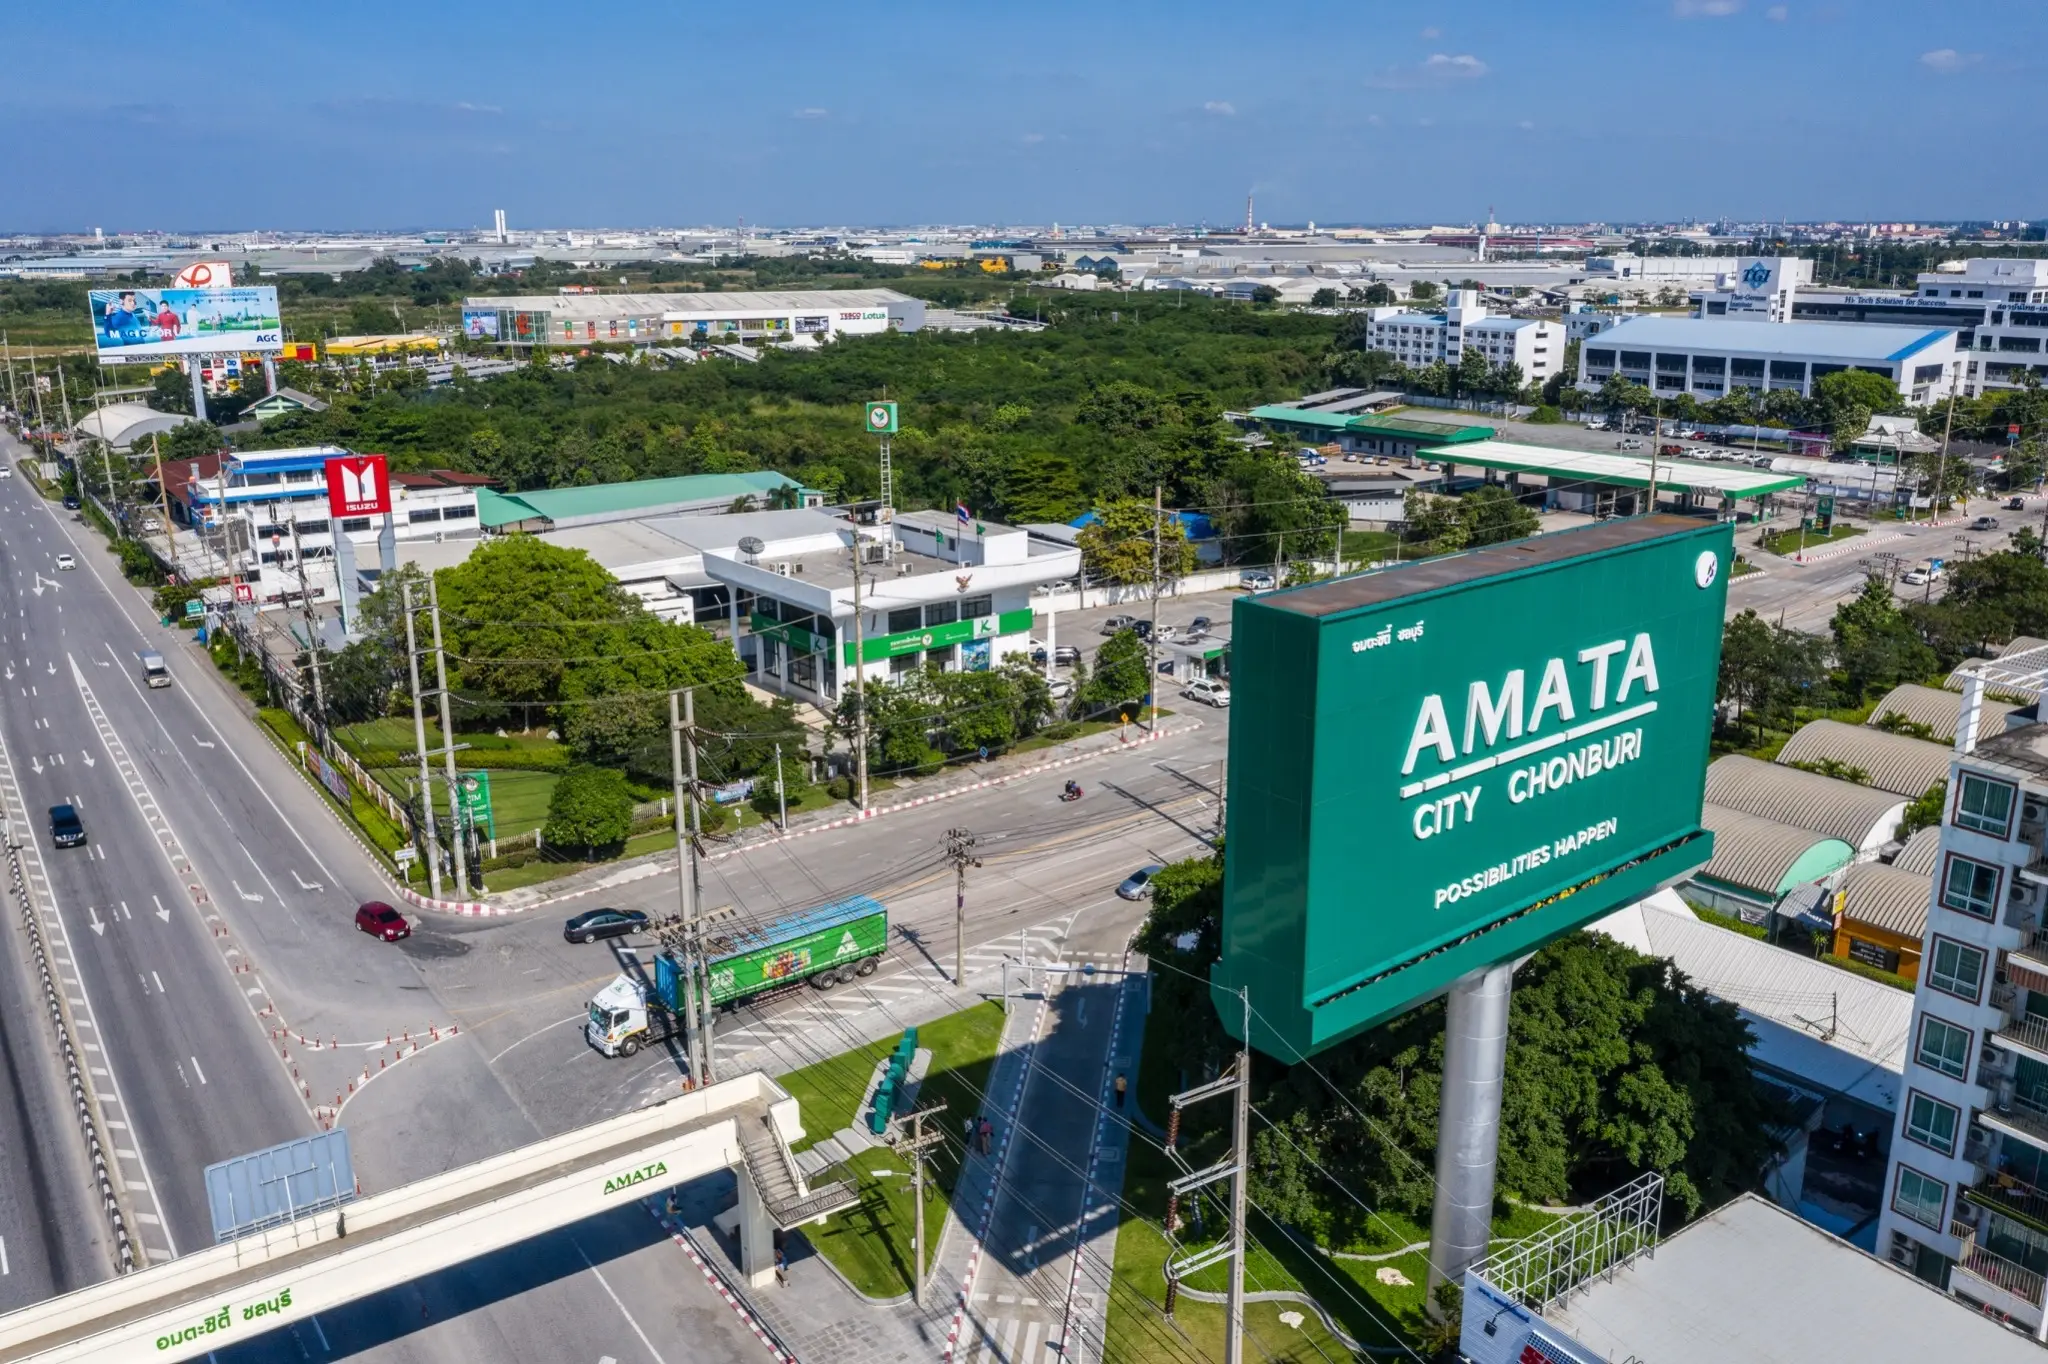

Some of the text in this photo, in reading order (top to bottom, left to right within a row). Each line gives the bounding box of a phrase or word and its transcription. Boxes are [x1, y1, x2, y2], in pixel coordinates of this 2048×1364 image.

[1742, 269, 1772, 282] TGI
[1875, 296, 1904, 305] Solution
[1905, 298, 1916, 306] for
[1918, 298, 1947, 306] Success
[840, 312, 886, 320] TESCO Lotus
[109, 329, 148, 339] MAGIC
[256, 334, 278, 343] AGC
[346, 502, 378, 511] ISUZU
[1401, 632, 1660, 776] AMATA
[1413, 728, 1643, 840] CITY CHONBURI
[1434, 817, 1618, 909] POSSIBILITIES HAPPEN
[604, 1161, 667, 1193] AMATA
[156, 1288, 292, 1350] อมตะซิตี้ ชลบุรี
